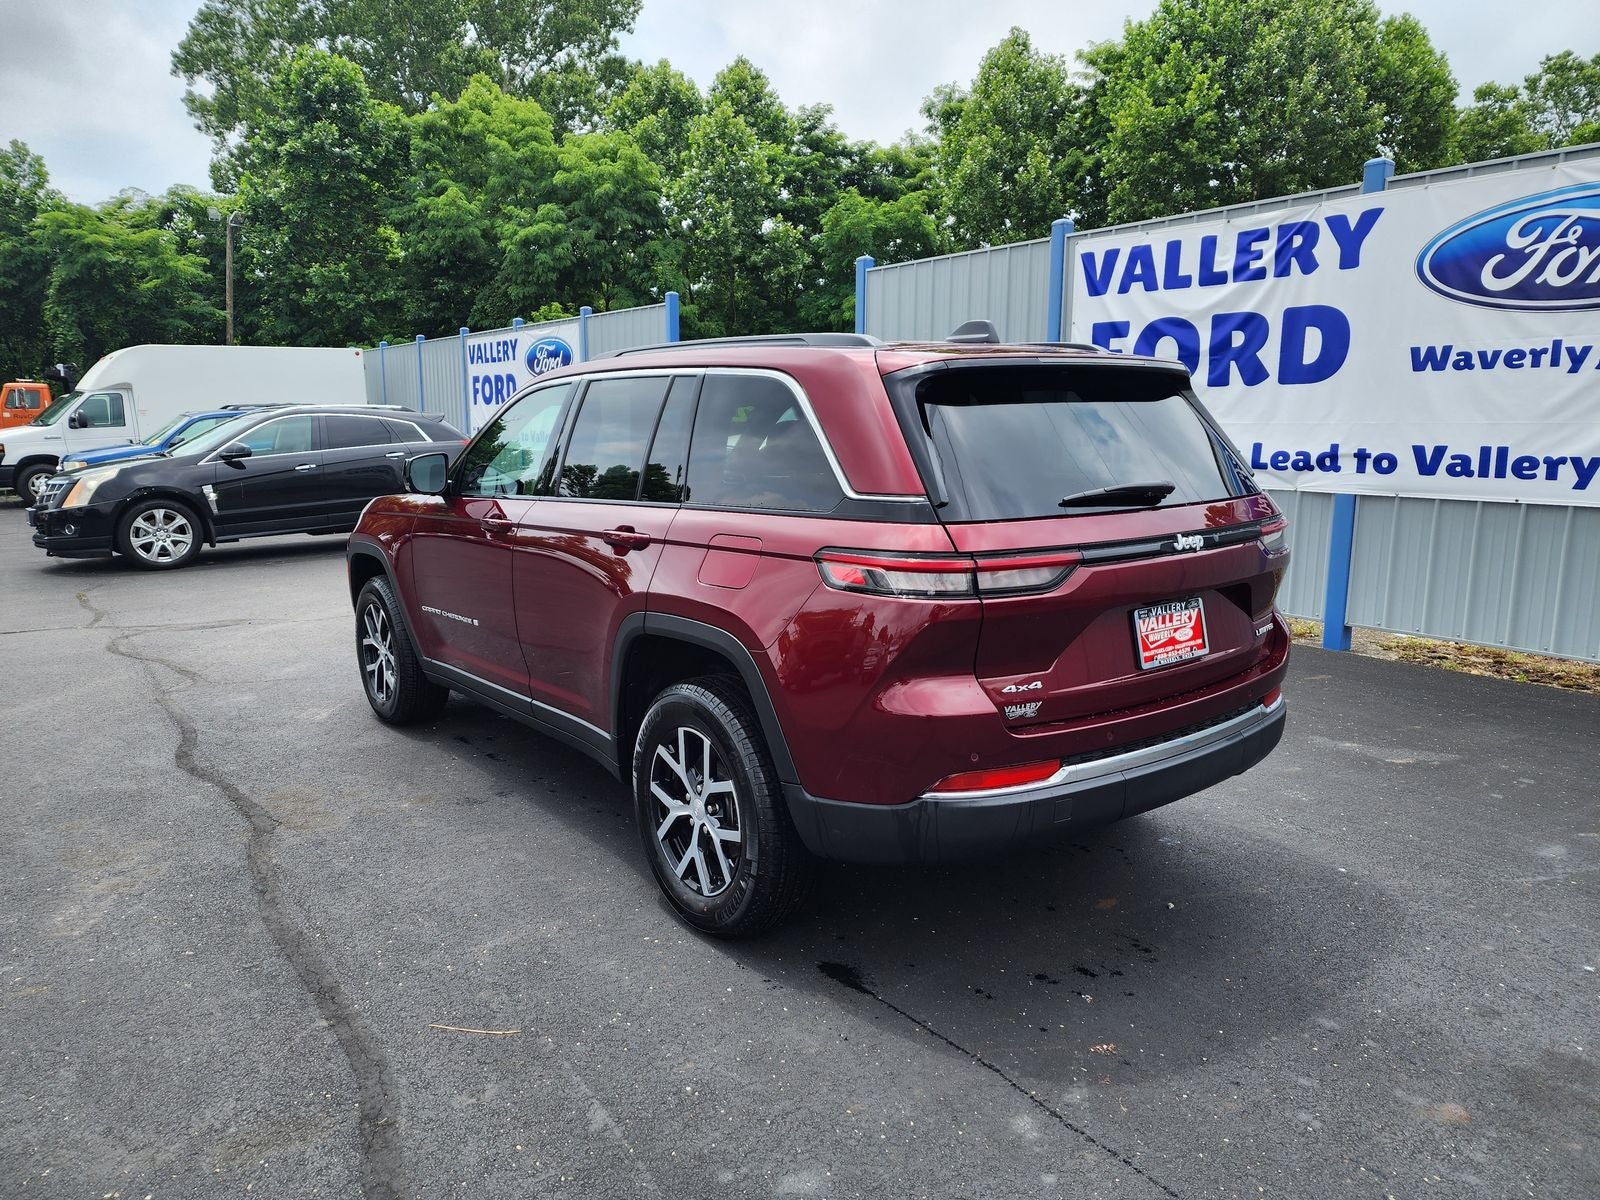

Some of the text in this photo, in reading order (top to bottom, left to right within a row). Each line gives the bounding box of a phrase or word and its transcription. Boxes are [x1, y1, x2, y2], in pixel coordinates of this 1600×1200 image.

[1080, 207, 1385, 297] VALLERY
[468, 338, 518, 365] VALLERY
[533, 344, 564, 373] Ford
[1410, 338, 1594, 374] Waverly
[472, 373, 518, 406] FORD
[1250, 442, 1600, 491] Lead to Vallery
[1173, 533, 1204, 551] Jeep
[1139, 608, 1199, 633] VALLERY
[1151, 601, 1187, 616] VALLERY
[1001, 681, 1043, 693] 4x4
[1004, 701, 1043, 713] VALLERY
